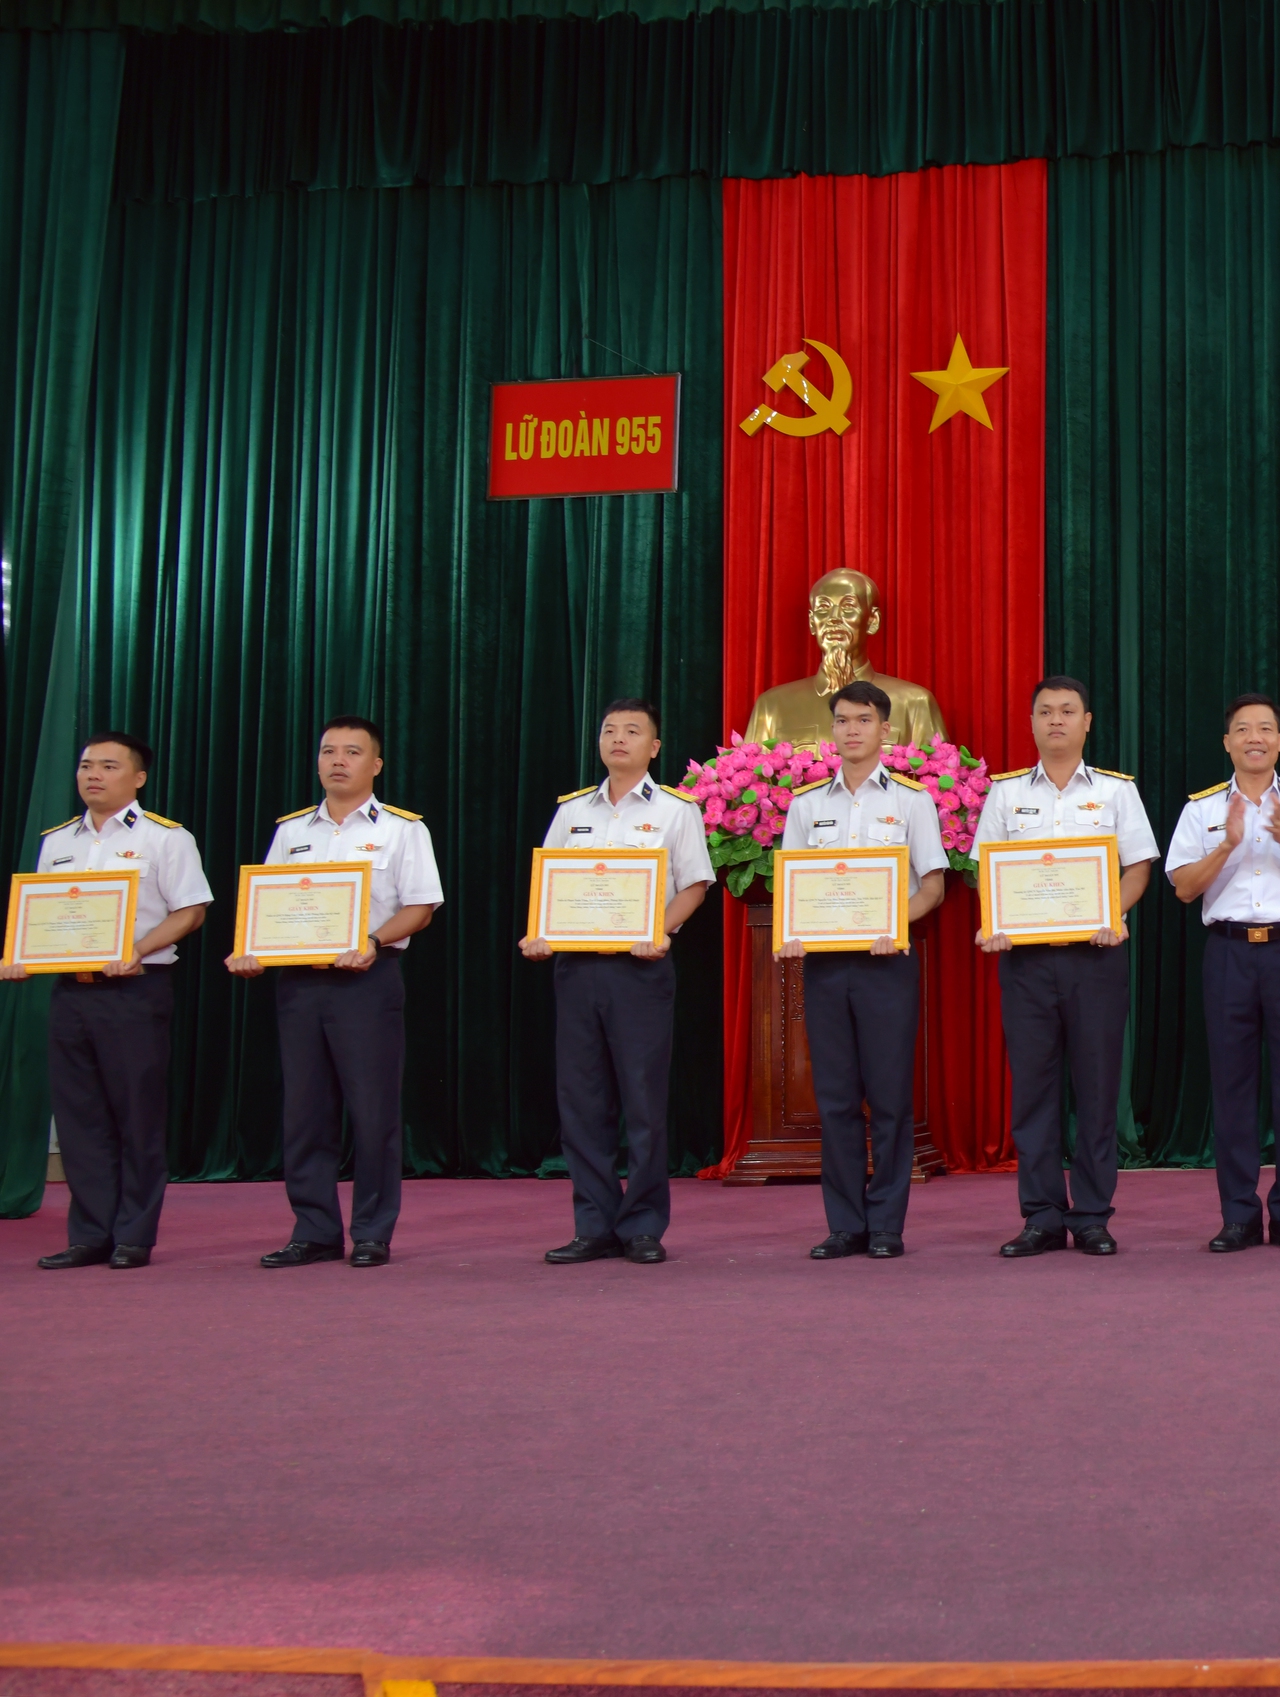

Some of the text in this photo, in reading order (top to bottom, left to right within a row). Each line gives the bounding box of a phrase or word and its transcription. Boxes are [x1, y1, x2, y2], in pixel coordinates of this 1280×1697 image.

[505, 411, 662, 460] LỮ ĐOÀN 955
